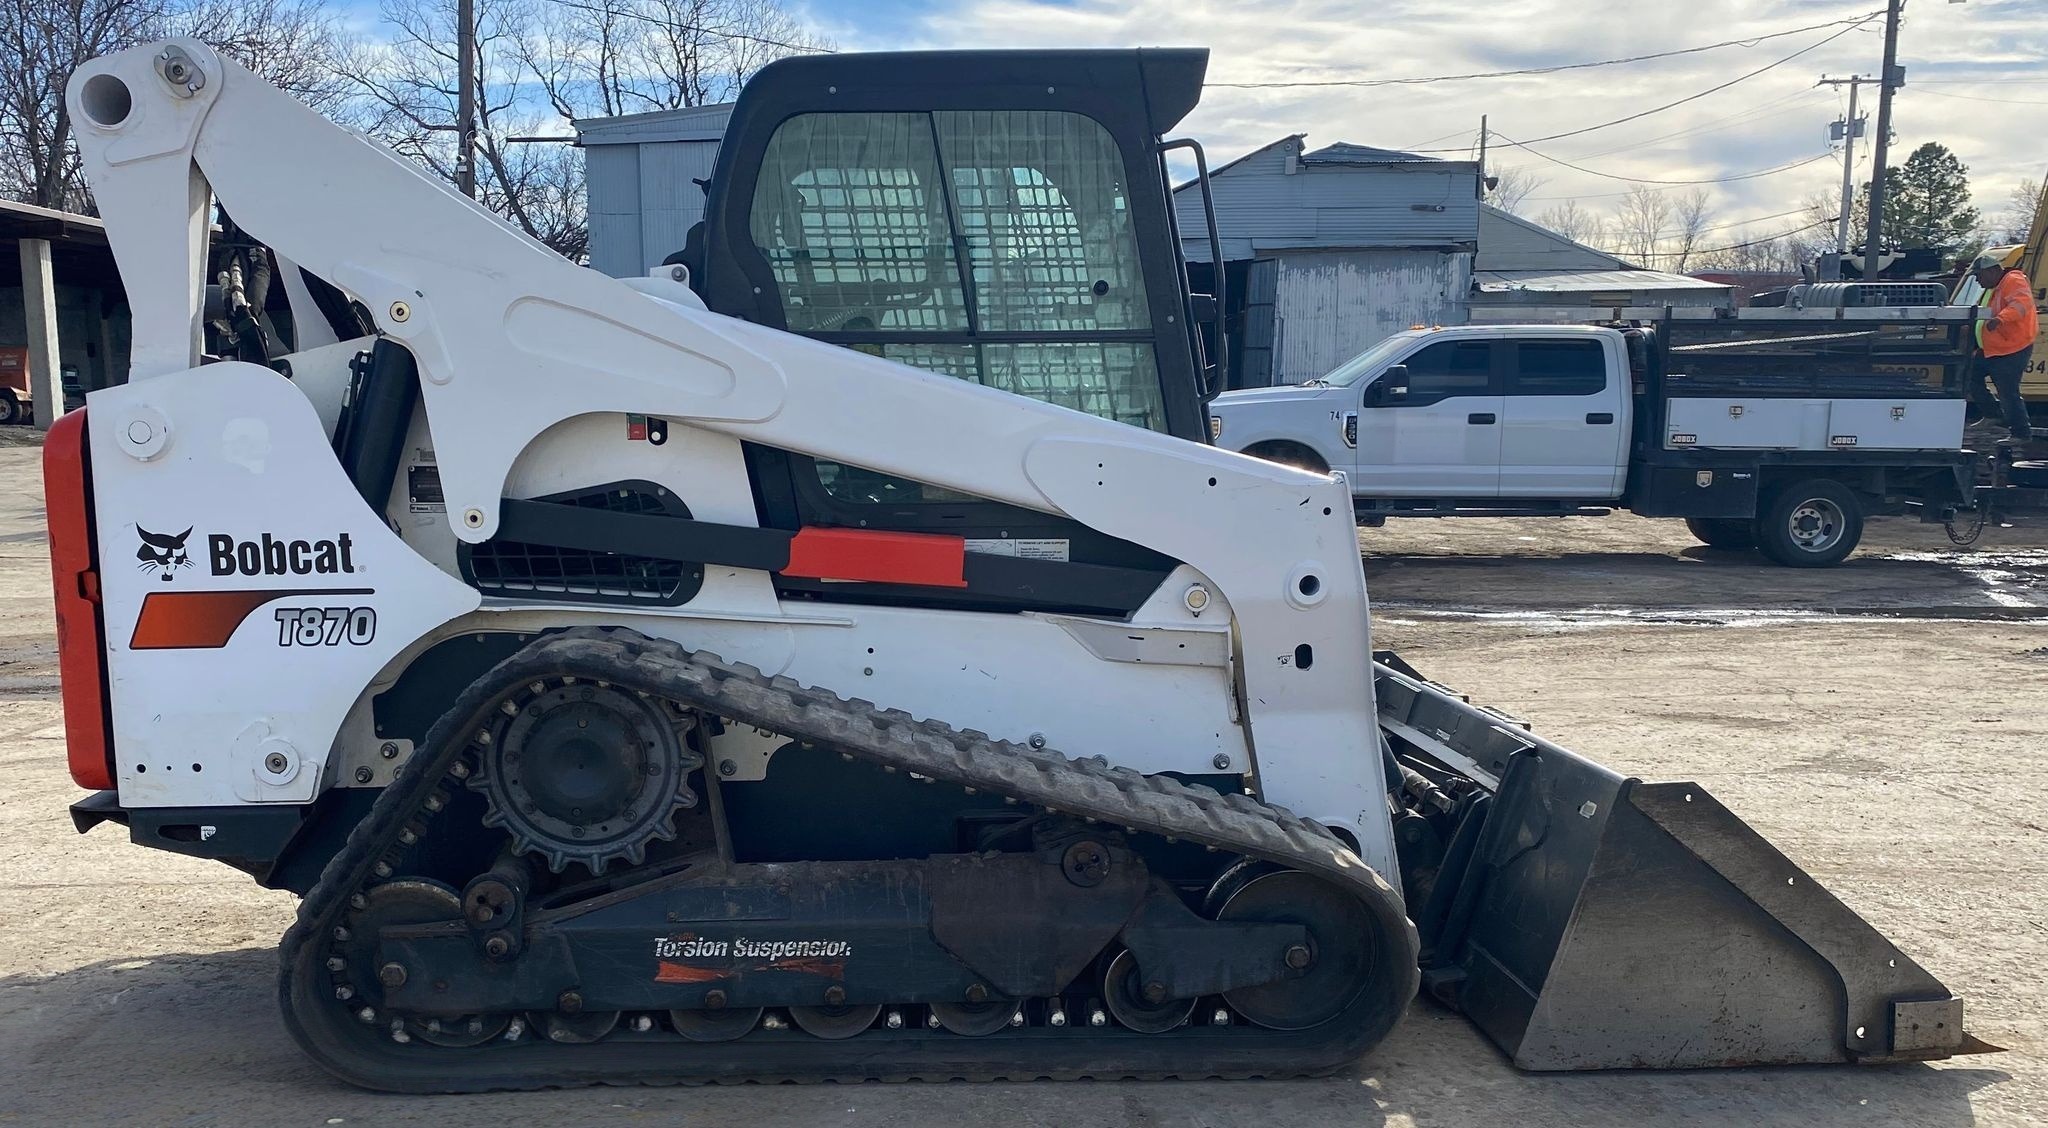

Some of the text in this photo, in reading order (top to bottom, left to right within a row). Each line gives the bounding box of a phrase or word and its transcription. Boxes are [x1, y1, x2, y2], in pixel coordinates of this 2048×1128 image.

[1330, 411, 1340, 420] 74
[1672, 435, 1696, 443] JOBOX
[1832, 436, 1857, 445] JOBOX
[208, 533, 355, 577] Bobcat
[275, 607, 377, 647] T870
[654, 937, 728, 958] Torsion
